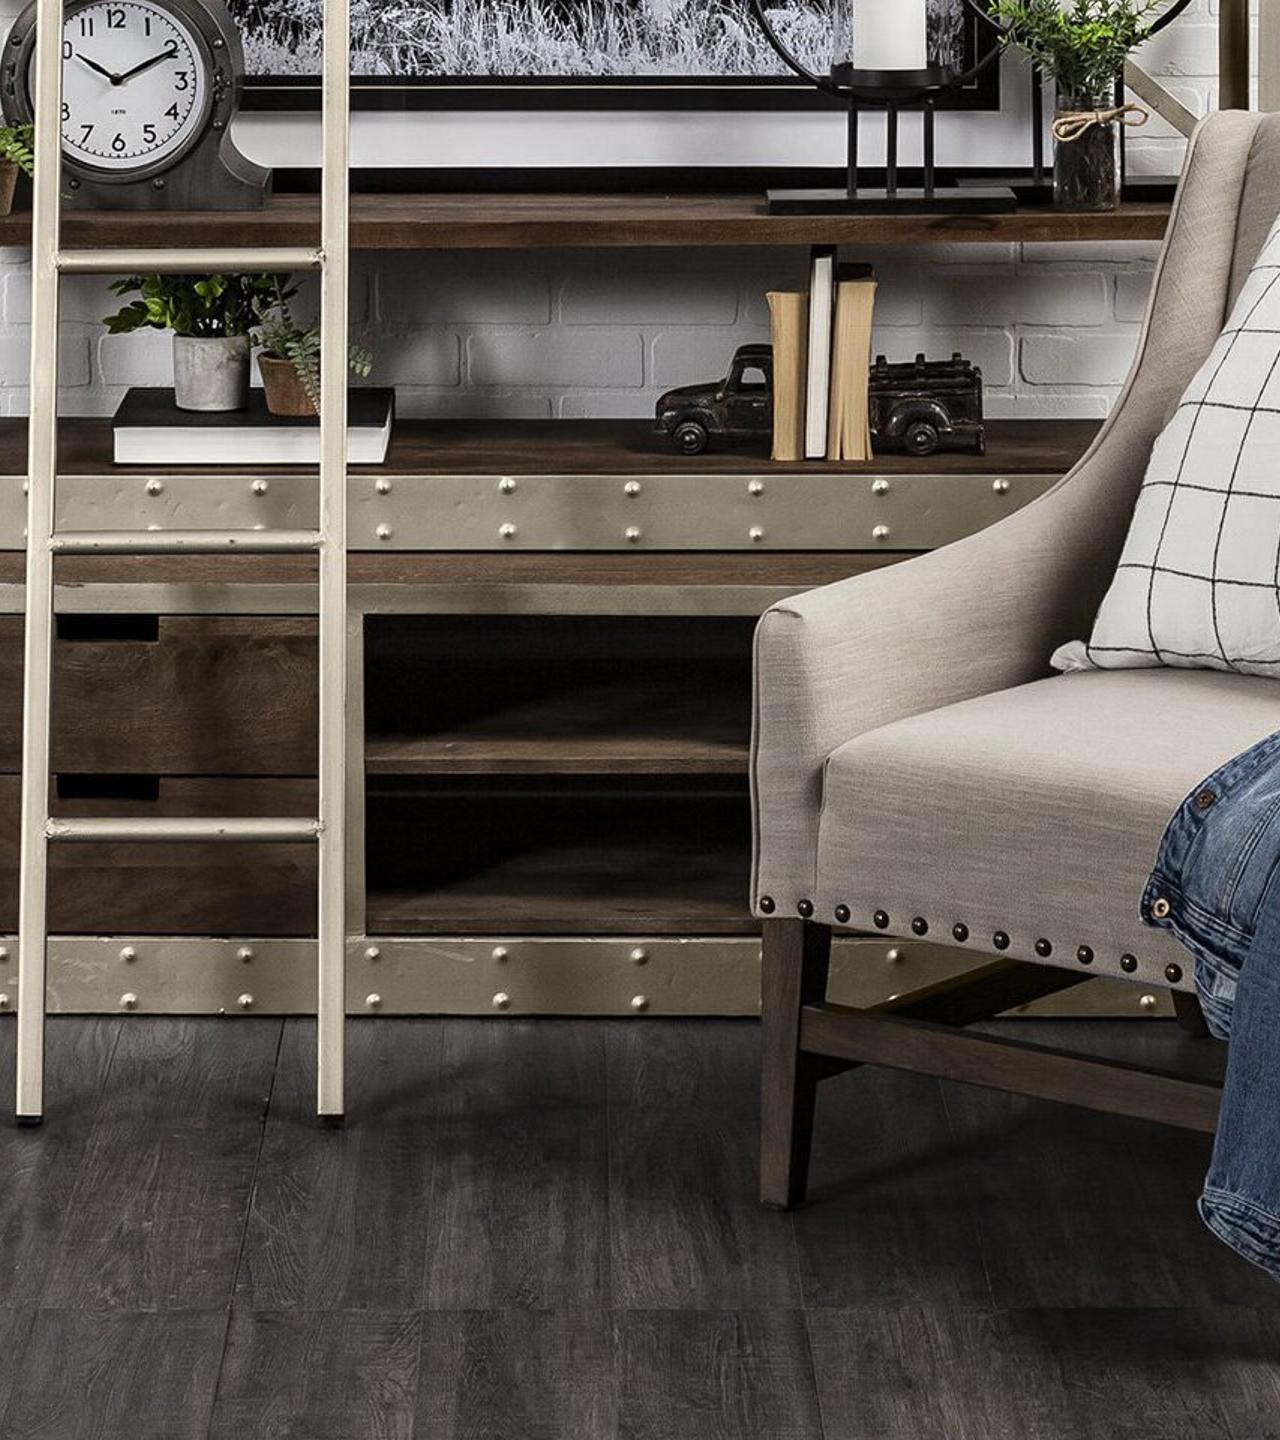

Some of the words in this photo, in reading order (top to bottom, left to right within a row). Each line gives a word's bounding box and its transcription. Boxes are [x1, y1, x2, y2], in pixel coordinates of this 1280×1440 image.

[81, 17, 94, 37] 11
[107, 9, 126, 28] 12
[145, 17, 150, 36] 1
[164, 39, 178, 59] 2
[174, 71, 188, 91] 3
[164, 101, 180, 121] 4
[80, 124, 95, 144] 7
[111, 133, 126, 152] 6
[143, 124, 157, 144] 5
